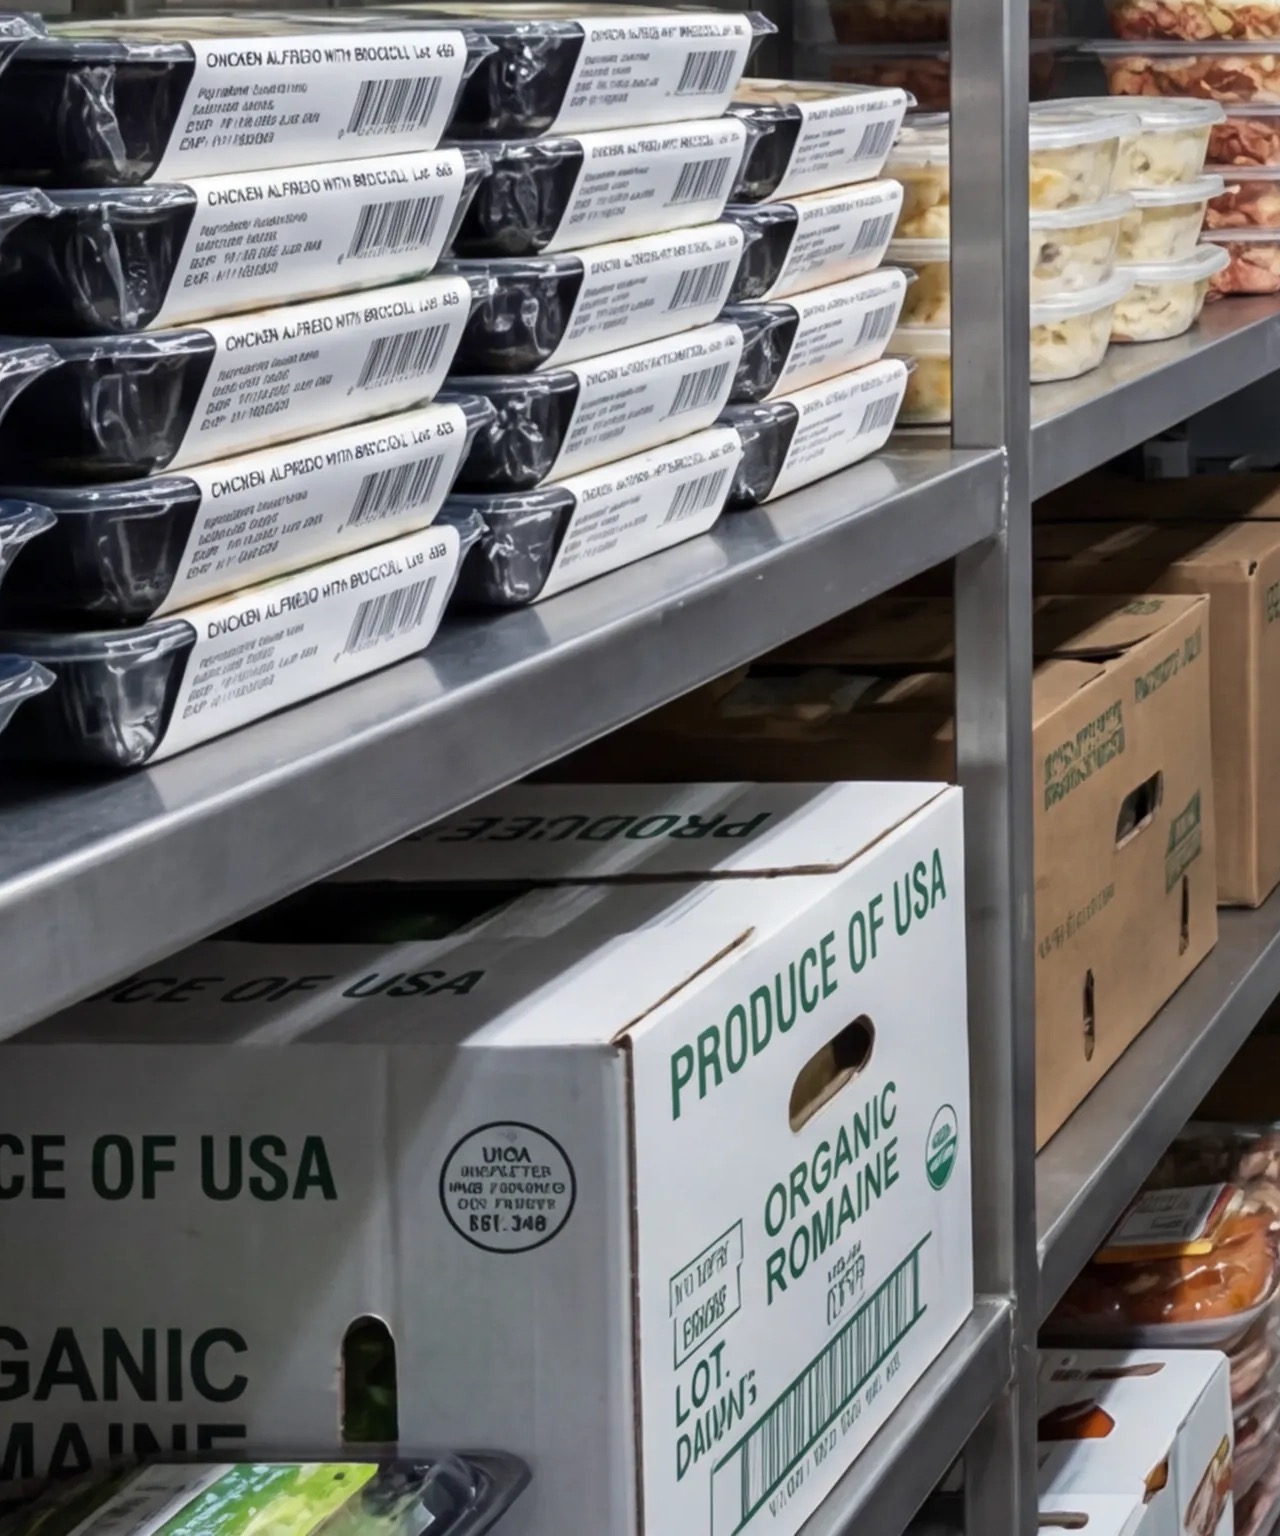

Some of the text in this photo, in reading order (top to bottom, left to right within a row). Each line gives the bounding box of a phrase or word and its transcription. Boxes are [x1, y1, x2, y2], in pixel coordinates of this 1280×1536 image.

[220, 975, 338, 1004] OF
[342, 969, 486, 999] USA
[670, 848, 947, 1122] PRODUCE OF USA
[92, 1133, 177, 1201] OF
[201, 1134, 338, 1202] USA
[763, 1080, 898, 1237] ORGANIC
[765, 1136, 901, 1306] ROMAINE
